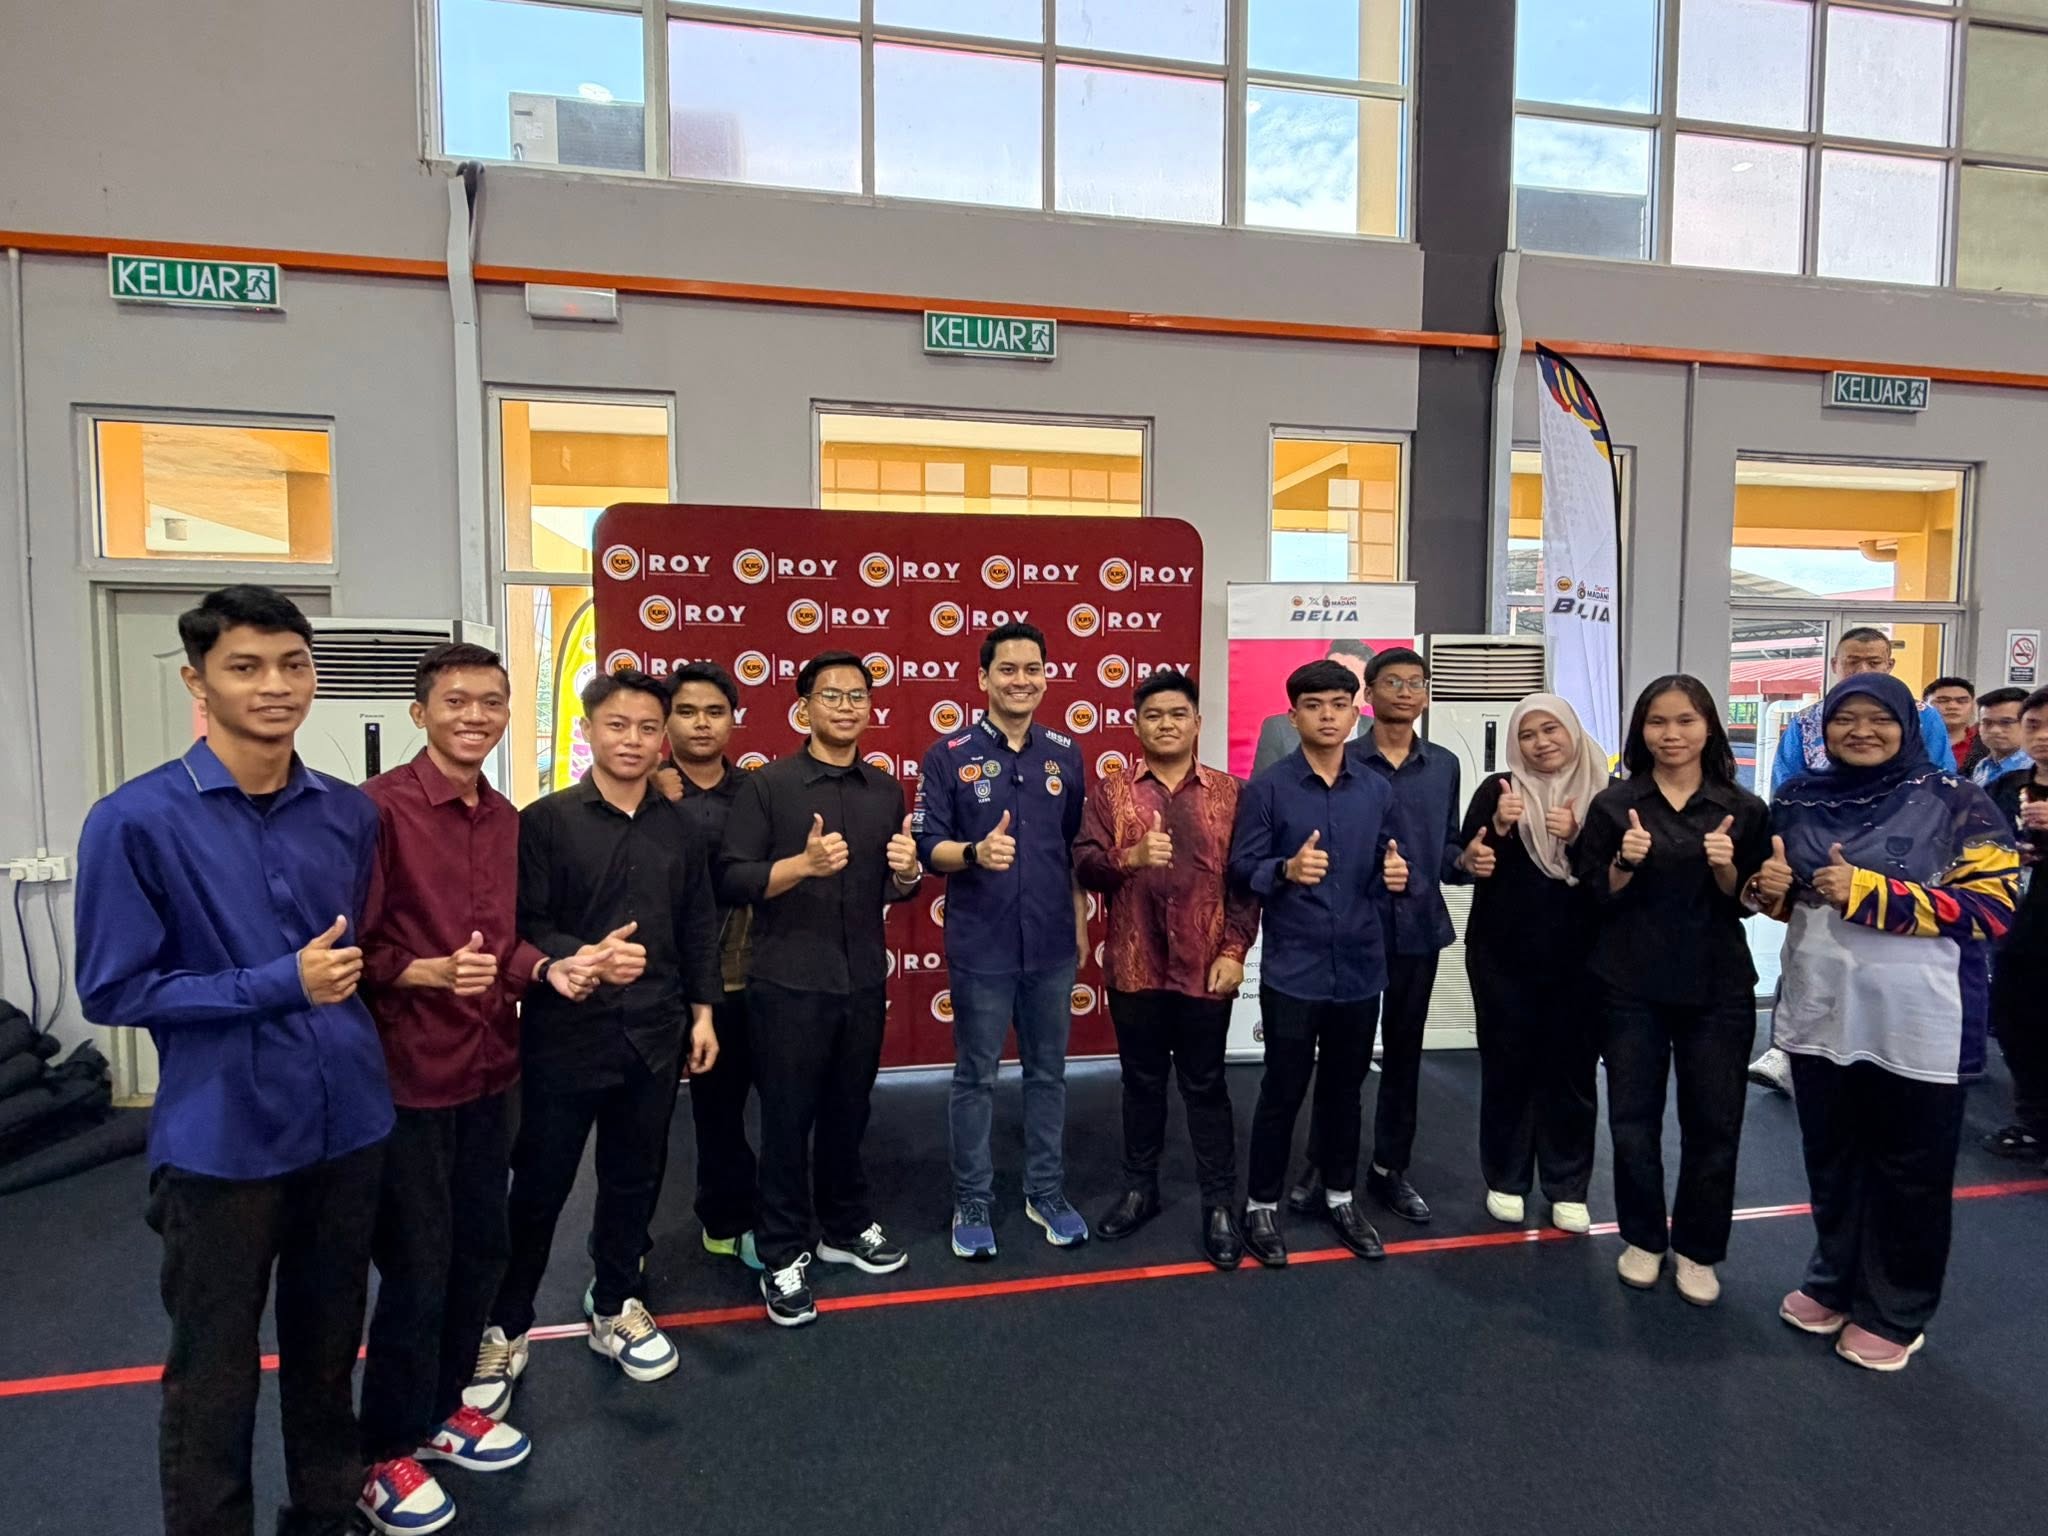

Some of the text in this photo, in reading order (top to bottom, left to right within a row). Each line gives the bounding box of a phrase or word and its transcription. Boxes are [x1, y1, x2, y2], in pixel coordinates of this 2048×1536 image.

[118, 260, 240, 299] KELUAR
[931, 316, 1026, 350] KELUAR
[1837, 375, 1908, 405] KELUAR
[649, 554, 711, 573] ROY
[778, 558, 838, 577] ROY
[902, 561, 960, 579] ROY
[1023, 564, 1080, 581] ROY
[1140, 566, 1194, 583] ROY
[685, 605, 746, 623] ROY
[831, 608, 890, 625] ROY
[972, 610, 1029, 627] ROY
[1108, 612, 1162, 629] ROY
[1290, 610, 1358, 621] BELIA
[902, 661, 960, 679] ROY
